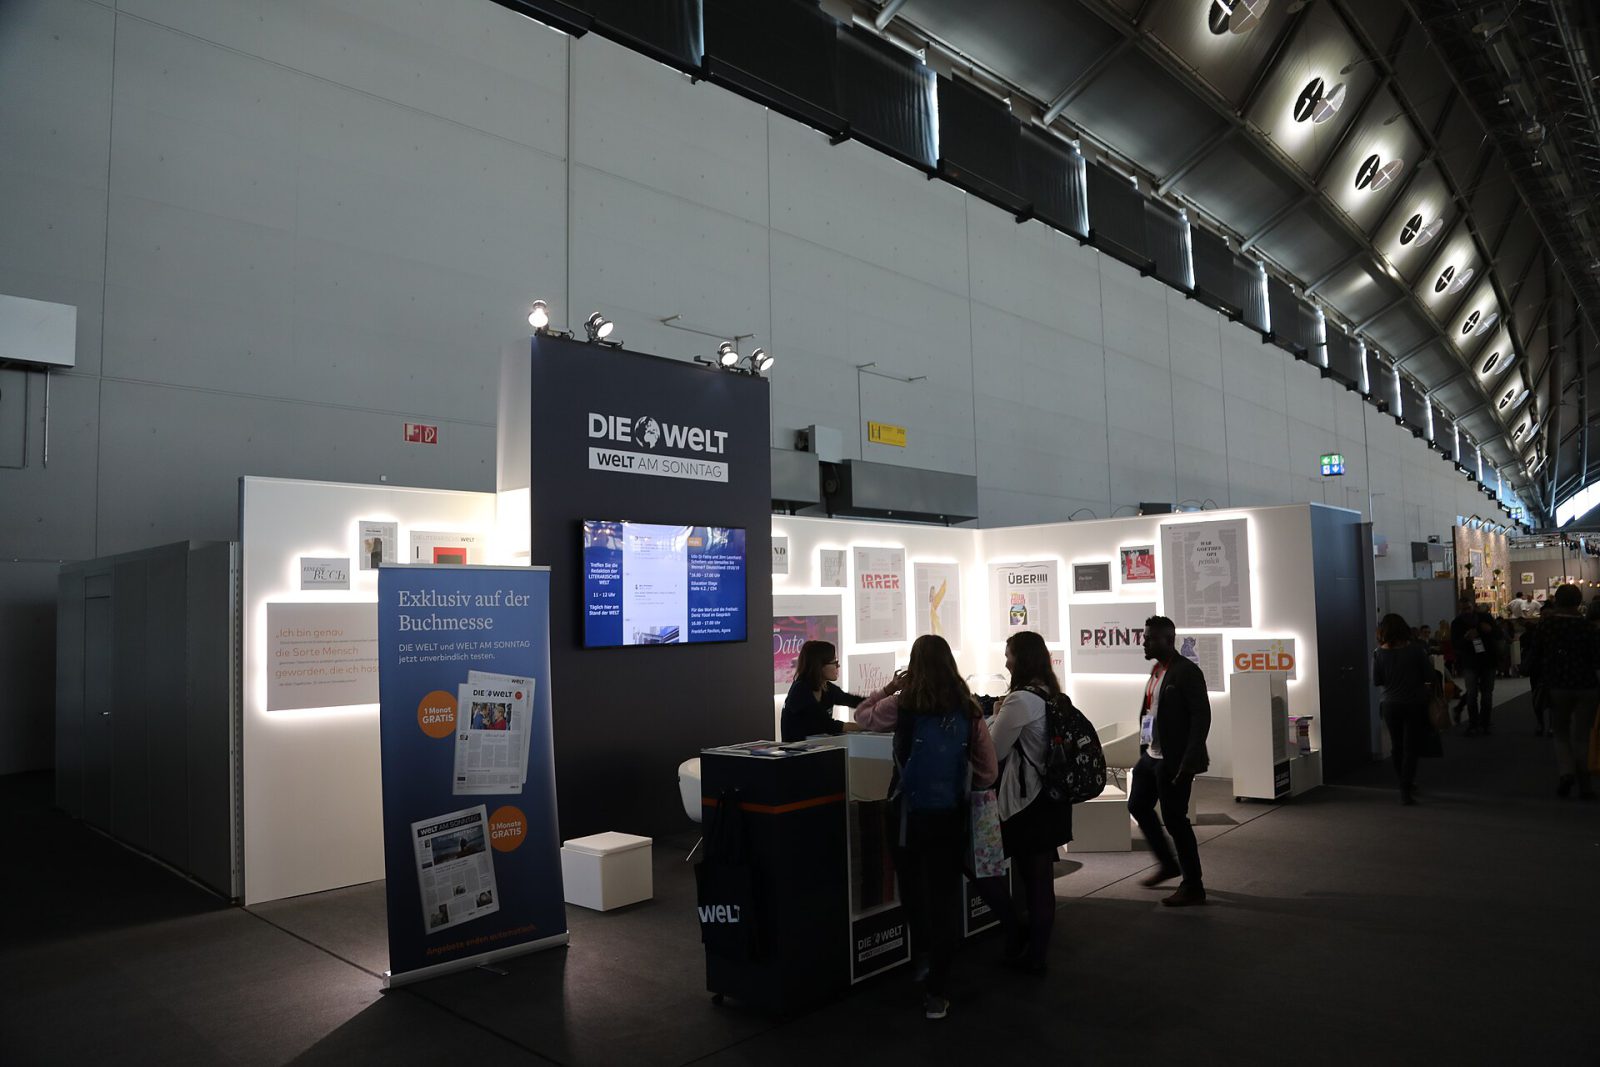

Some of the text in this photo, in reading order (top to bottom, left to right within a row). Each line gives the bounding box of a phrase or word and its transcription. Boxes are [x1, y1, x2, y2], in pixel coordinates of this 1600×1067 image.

[588, 412, 632, 442] DIE
[638, 457, 659, 472] AM
[662, 460, 722, 478] SONNTAG
[861, 573, 900, 589] IRRER
[398, 589, 530, 607] Exklusiv auf der
[398, 614, 493, 632] Buchmesse
[296, 627, 311, 637] bin
[275, 646, 359, 657] die Sorte Mensch
[399, 644, 413, 652] DIE
[415, 643, 438, 651] WELT
[455, 642, 478, 650] WELT
[480, 641, 492, 649] AM
[493, 640, 530, 649] SONNTAG
[398, 655, 418, 664] jetzt
[419, 653, 469, 662] unverbindlich
[1234, 653, 1294, 671] GELD
[472, 689, 485, 697] DIE
[422, 714, 454, 724] GRATIS
[496, 820, 522, 830] Monate
[491, 827, 522, 839] GRATIS
[857, 935, 871, 951] DIE
